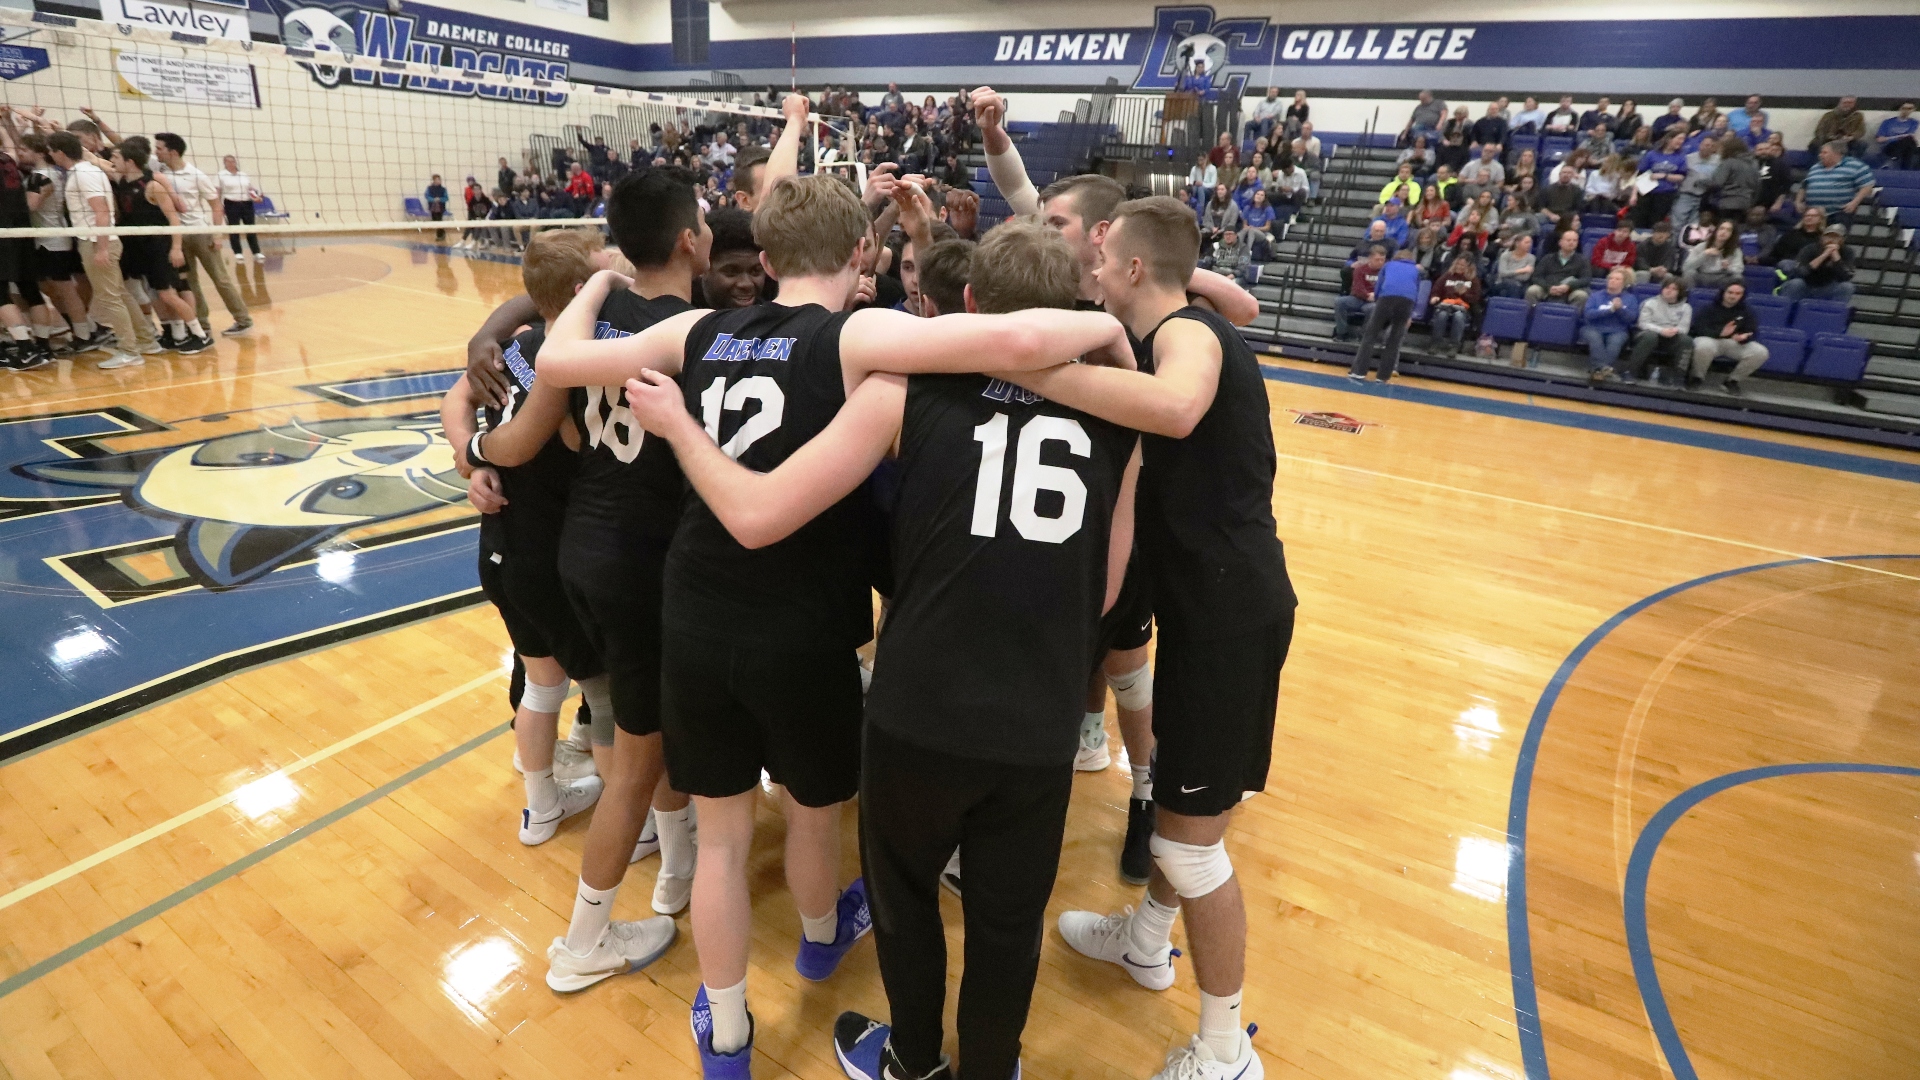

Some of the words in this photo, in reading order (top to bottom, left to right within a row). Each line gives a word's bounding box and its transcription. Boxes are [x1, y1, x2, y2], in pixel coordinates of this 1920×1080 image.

[120, 0, 230, 37] Lawley
[427, 20, 499, 46] DAEMEN
[505, 34, 570, 58] COLLEGE
[351, 10, 568, 106] WILDCATS
[994, 33, 1131, 61] DAEMEN
[1282, 28, 1476, 61] COLLEGE
[503, 339, 537, 393] DAEME
[701, 333, 798, 361] DAEMEN
[700, 375, 786, 463] 12
[970, 411, 1092, 545] 16
